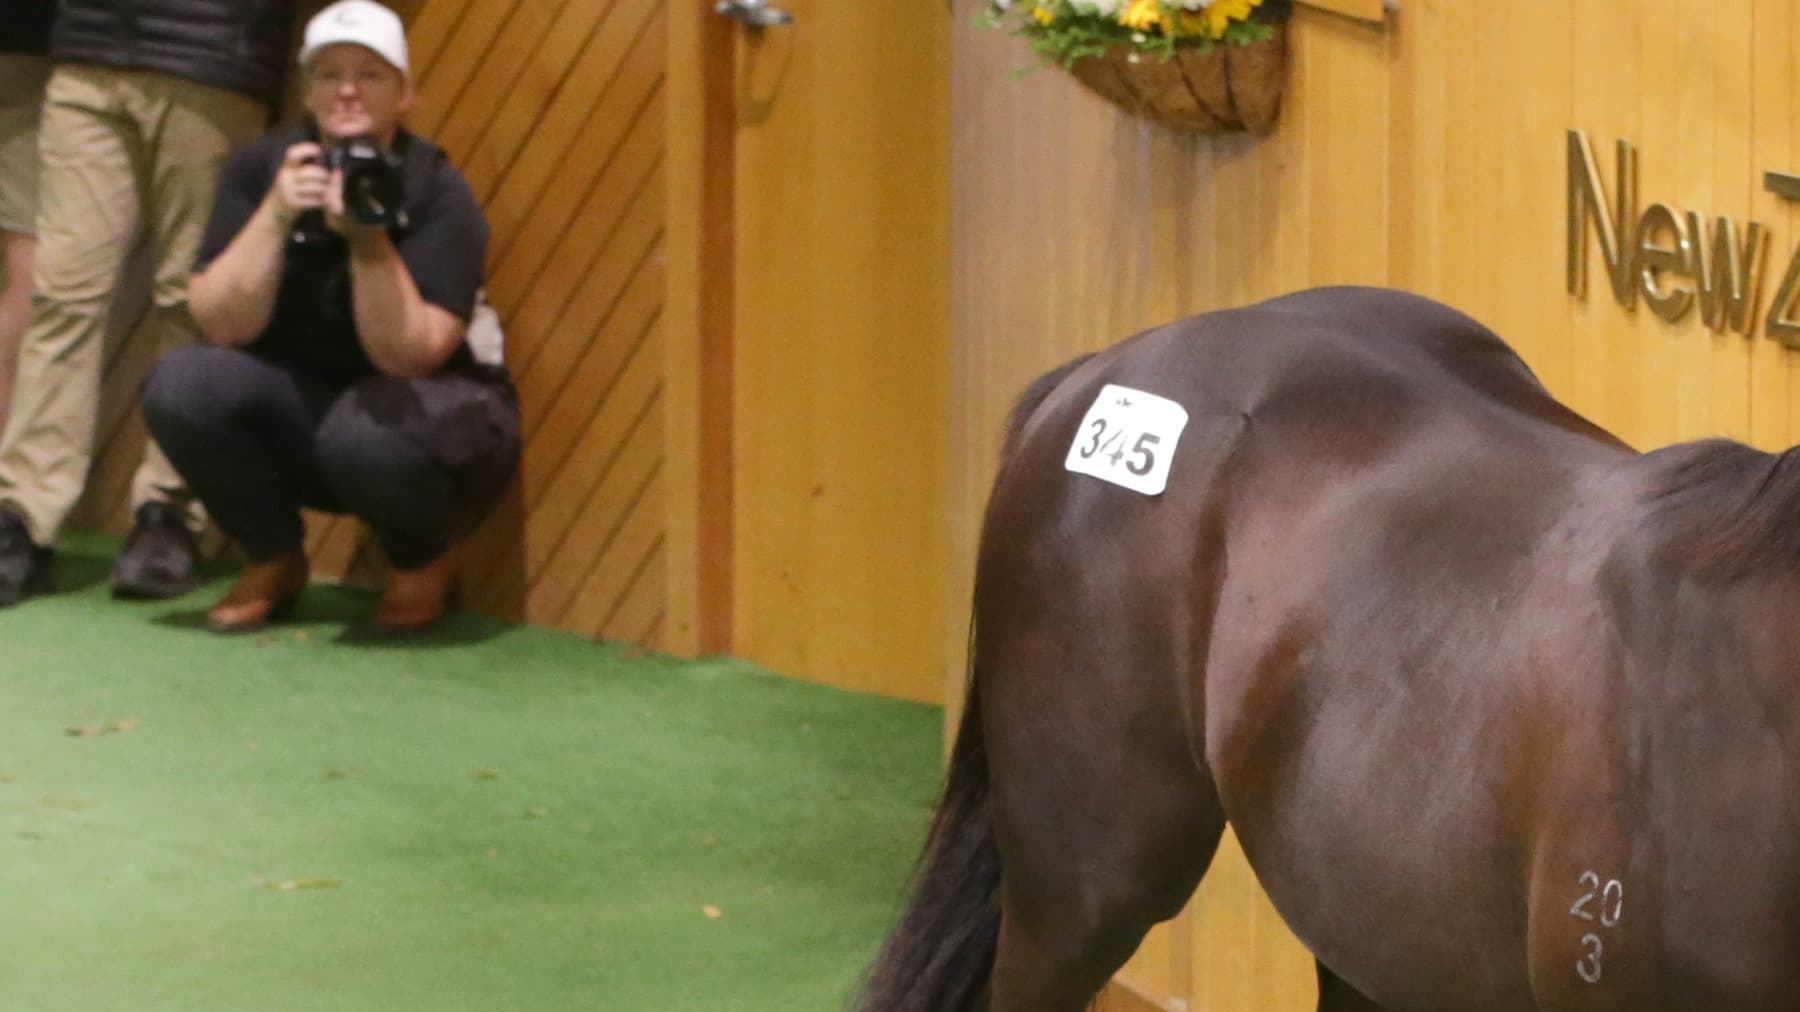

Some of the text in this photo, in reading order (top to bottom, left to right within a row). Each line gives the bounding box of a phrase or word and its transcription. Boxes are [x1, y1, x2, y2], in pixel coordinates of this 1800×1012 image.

[1080, 418, 1161, 476] 345
[1569, 870, 1624, 929] 20
[1576, 932, 1603, 984] 3
